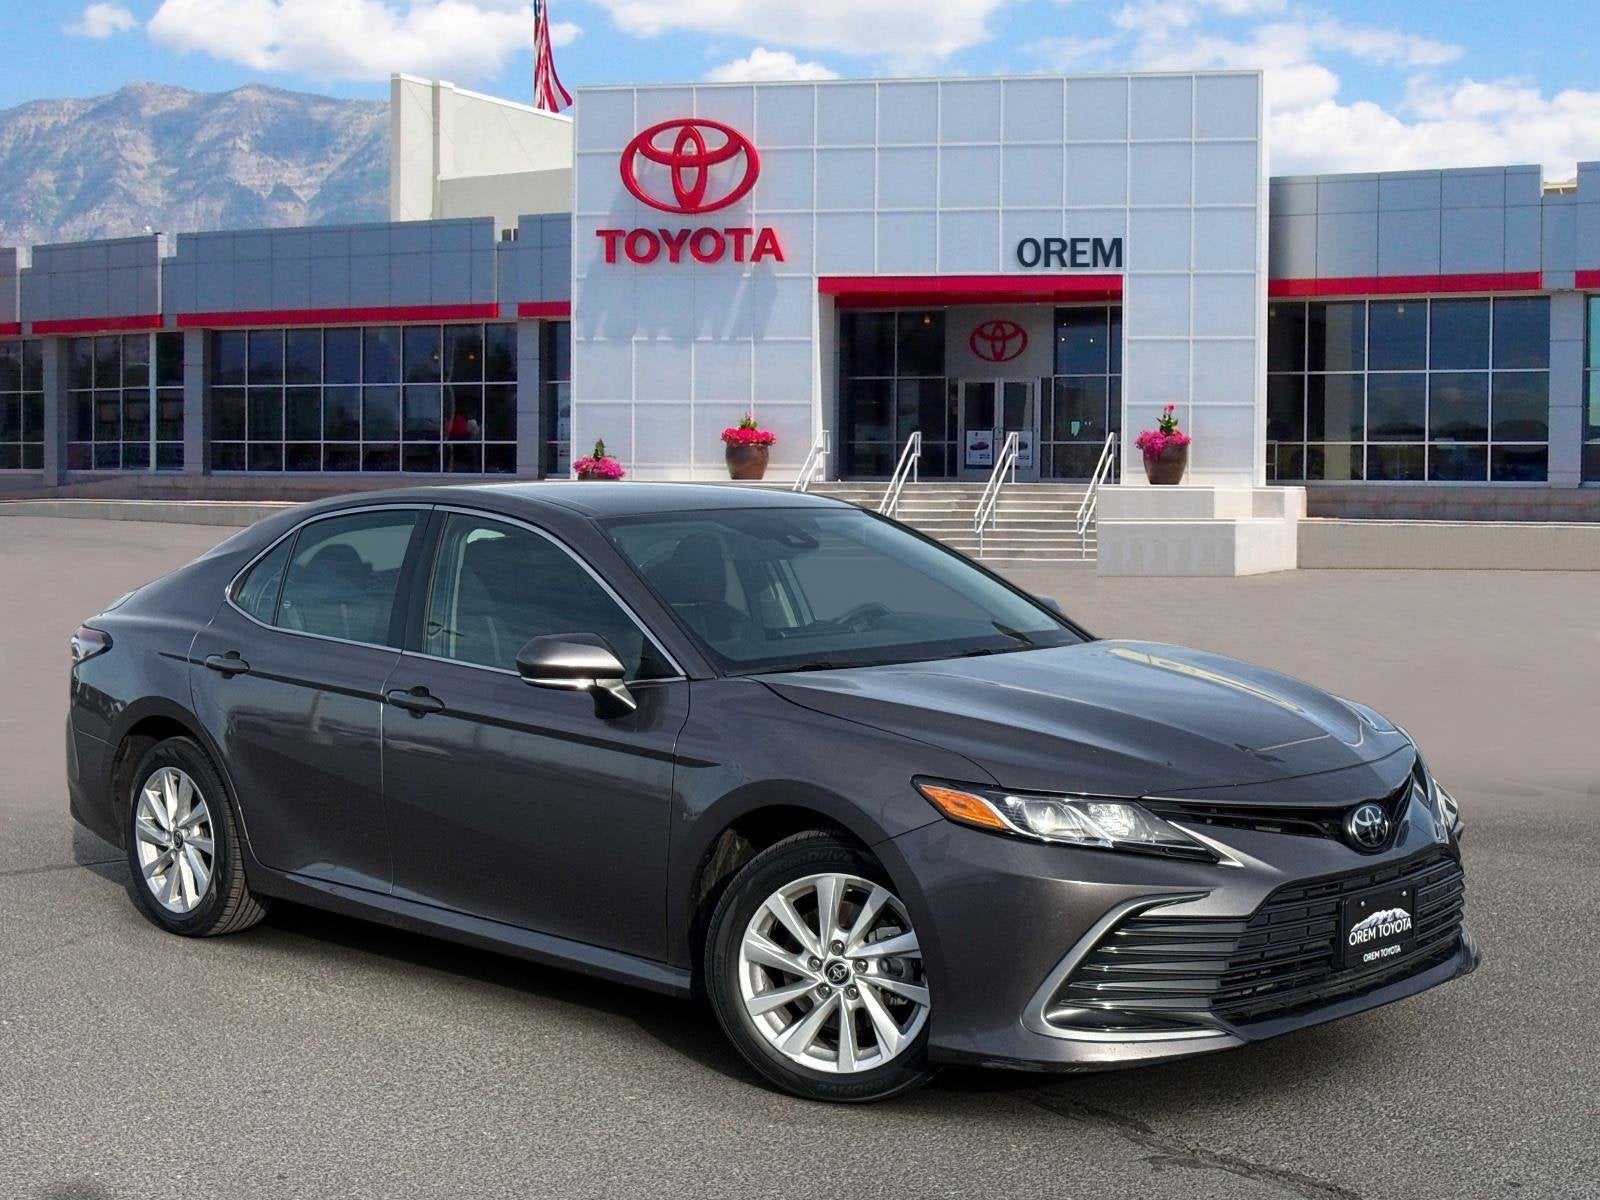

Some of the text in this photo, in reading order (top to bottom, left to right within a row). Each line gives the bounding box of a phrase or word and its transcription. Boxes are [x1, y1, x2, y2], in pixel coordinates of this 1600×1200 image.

[596, 227, 785, 264] TOYOTA
[1016, 237, 1123, 268] OREM
[1349, 917, 1412, 945] OREM TOYOTA
[1363, 944, 1401, 962] OREM TOYOTA
